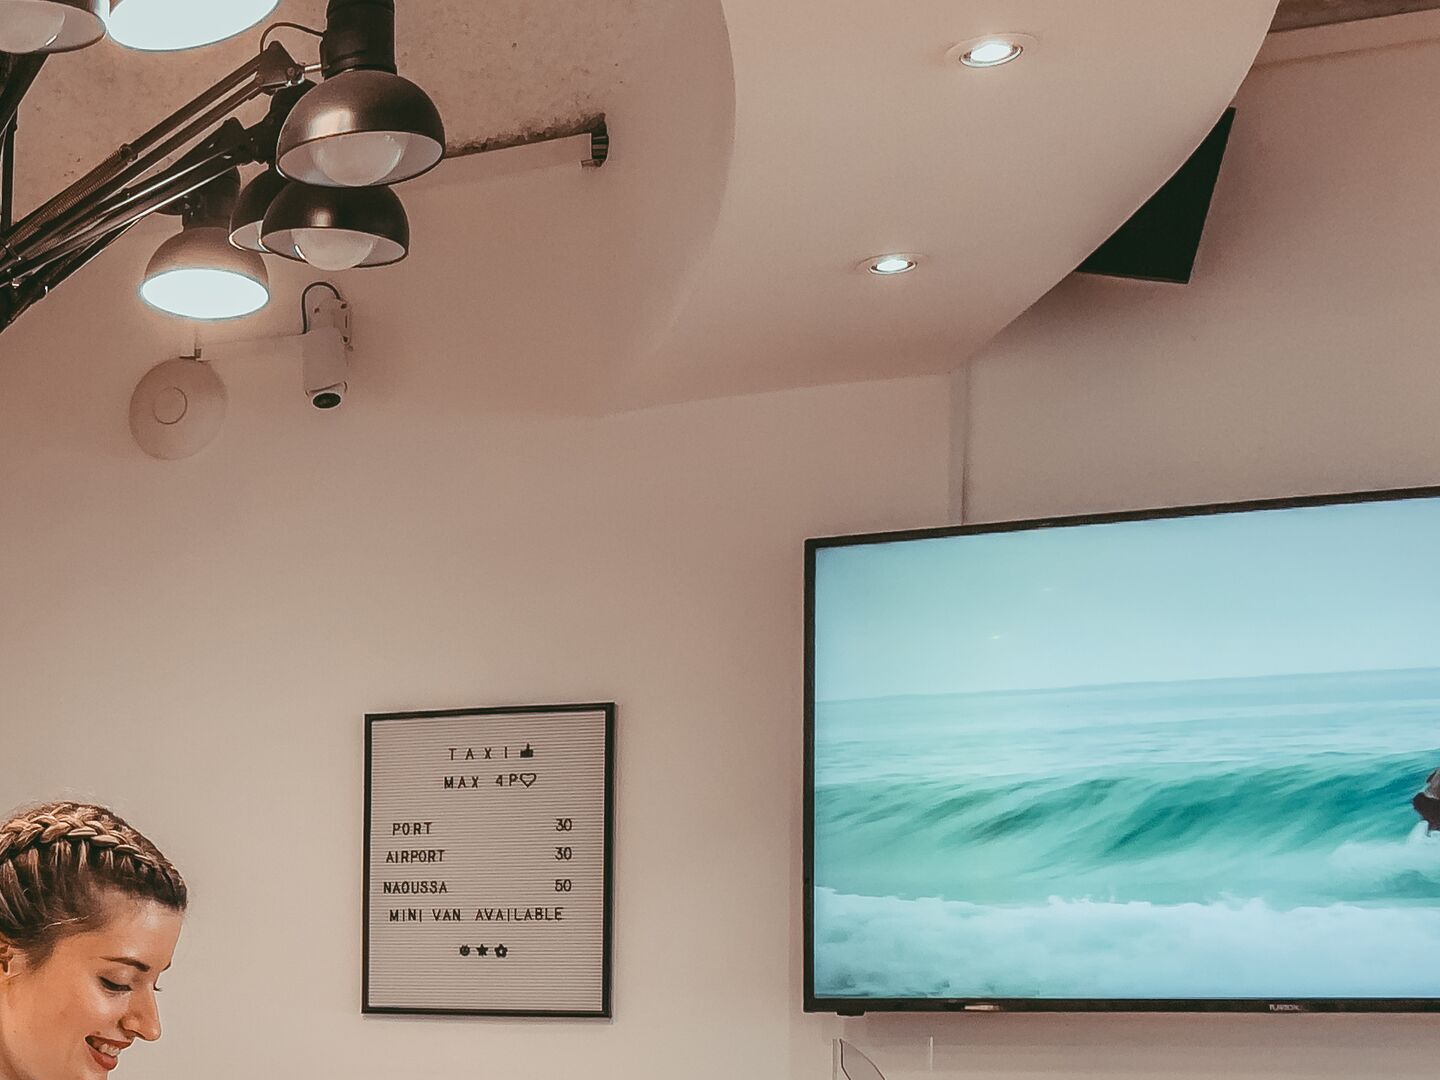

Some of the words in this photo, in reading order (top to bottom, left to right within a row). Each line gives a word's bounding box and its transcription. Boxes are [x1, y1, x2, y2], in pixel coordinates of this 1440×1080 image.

[448, 746, 509, 760] TAXI
[444, 775, 479, 789] MAX
[392, 822, 433, 836] PORT
[555, 818, 572, 831] 30
[385, 850, 445, 863] AIRPORT
[554, 847, 572, 860] 30
[383, 880, 448, 894] NAOUSSA
[389, 908, 422, 922] MINI
[432, 908, 461, 922] VAN
[475, 906, 563, 921] AVAILABLE
